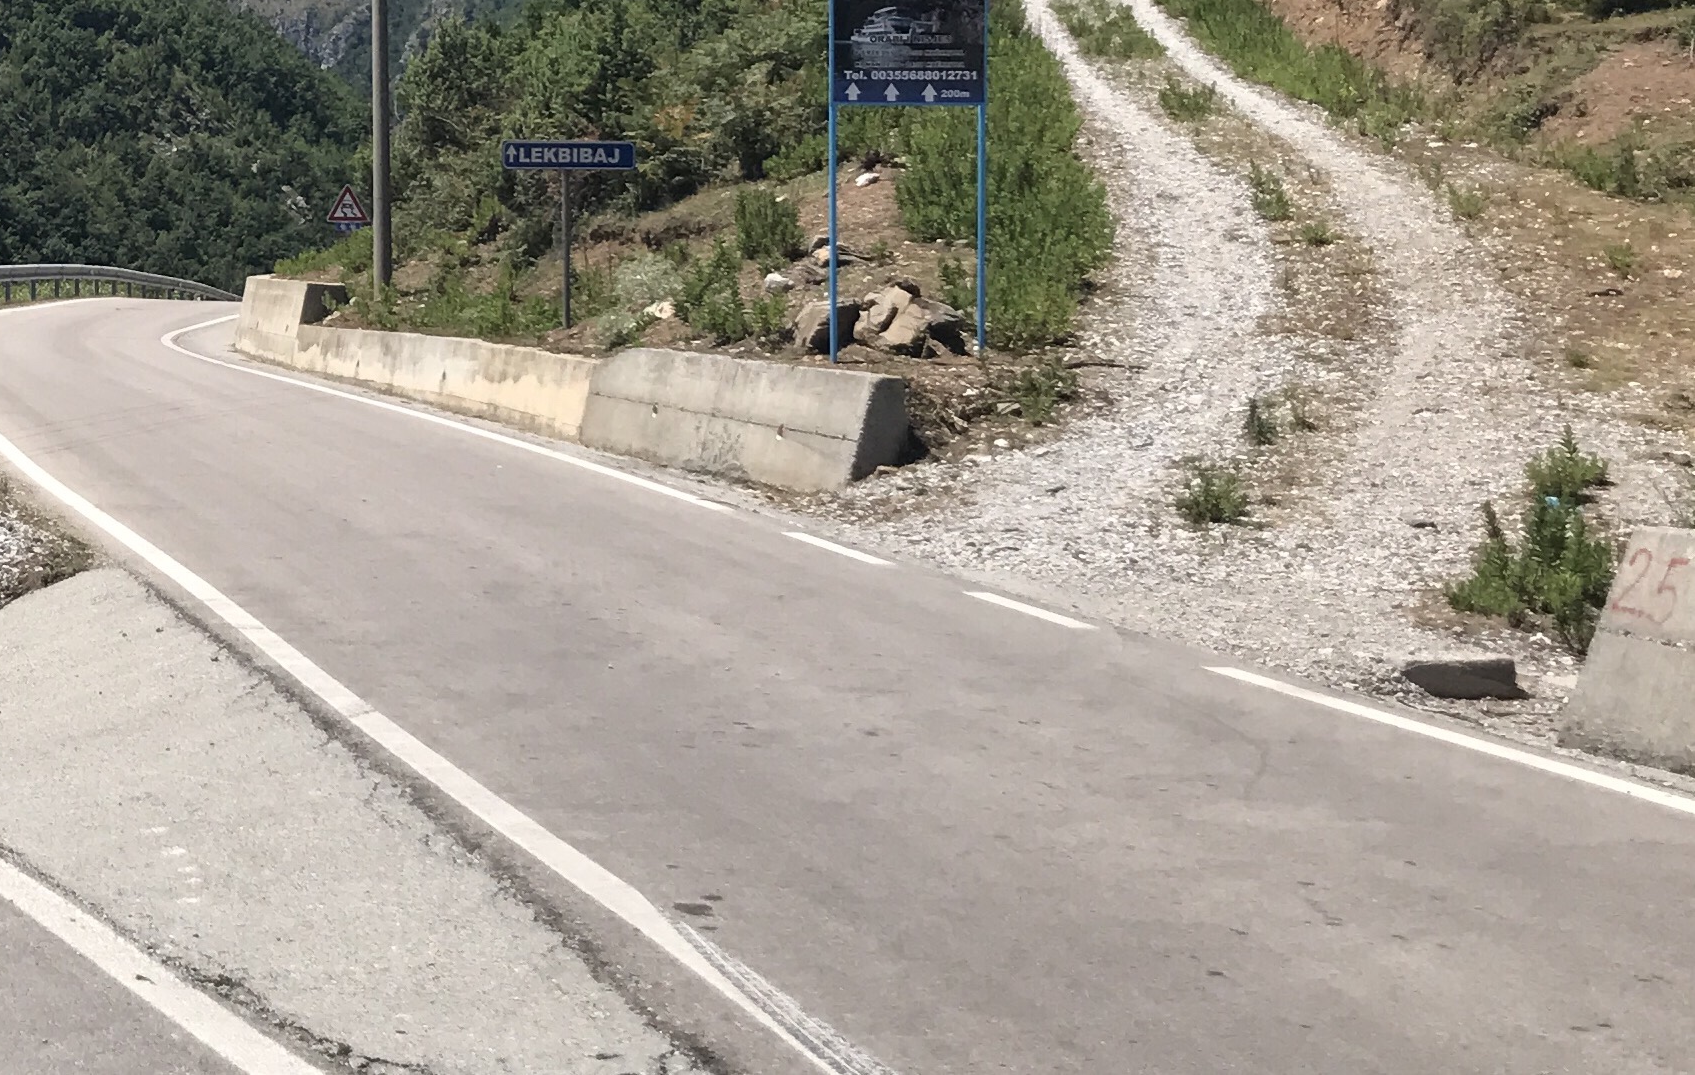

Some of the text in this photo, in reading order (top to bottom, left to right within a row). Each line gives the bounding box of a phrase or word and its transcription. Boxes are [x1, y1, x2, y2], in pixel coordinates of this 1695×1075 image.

[844, 70, 867, 80] Tel.
[519, 147, 620, 164] LEKBIBAJ
[1612, 548, 1691, 625] 25
